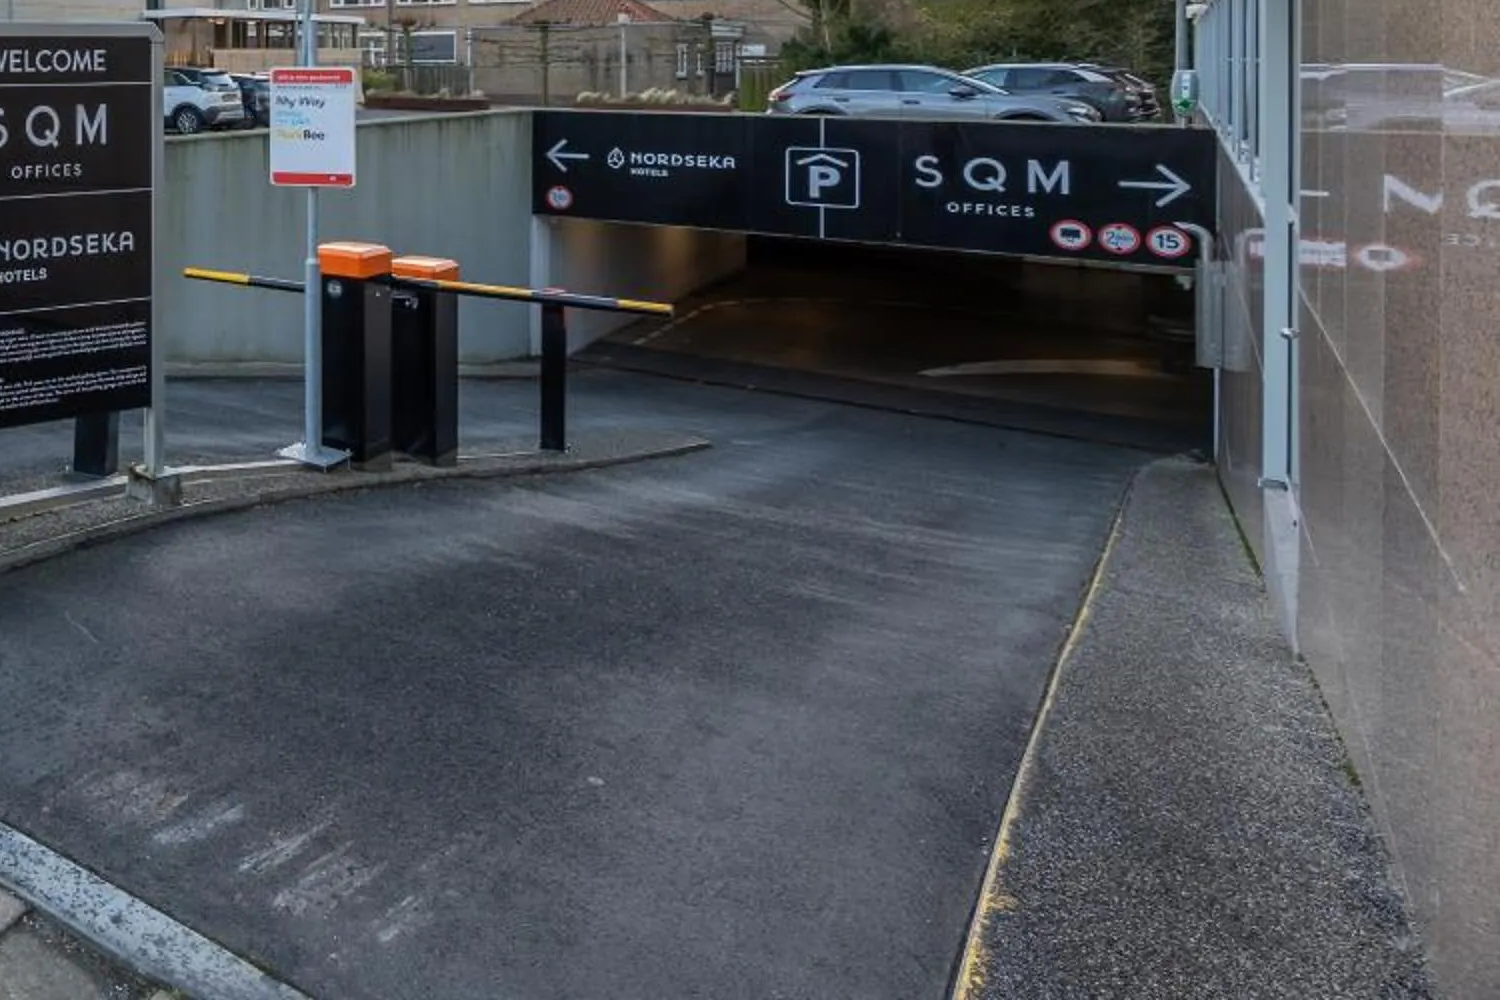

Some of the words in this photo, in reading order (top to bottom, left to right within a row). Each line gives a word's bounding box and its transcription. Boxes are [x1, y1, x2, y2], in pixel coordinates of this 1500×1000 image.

[630, 152, 736, 169] NORDSEKA
[11, 163, 82, 179] OFFICES
[808, 165, 841, 198] P
[946, 202, 1036, 218] OFFICES
[1155, 233, 1181, 249] 15
